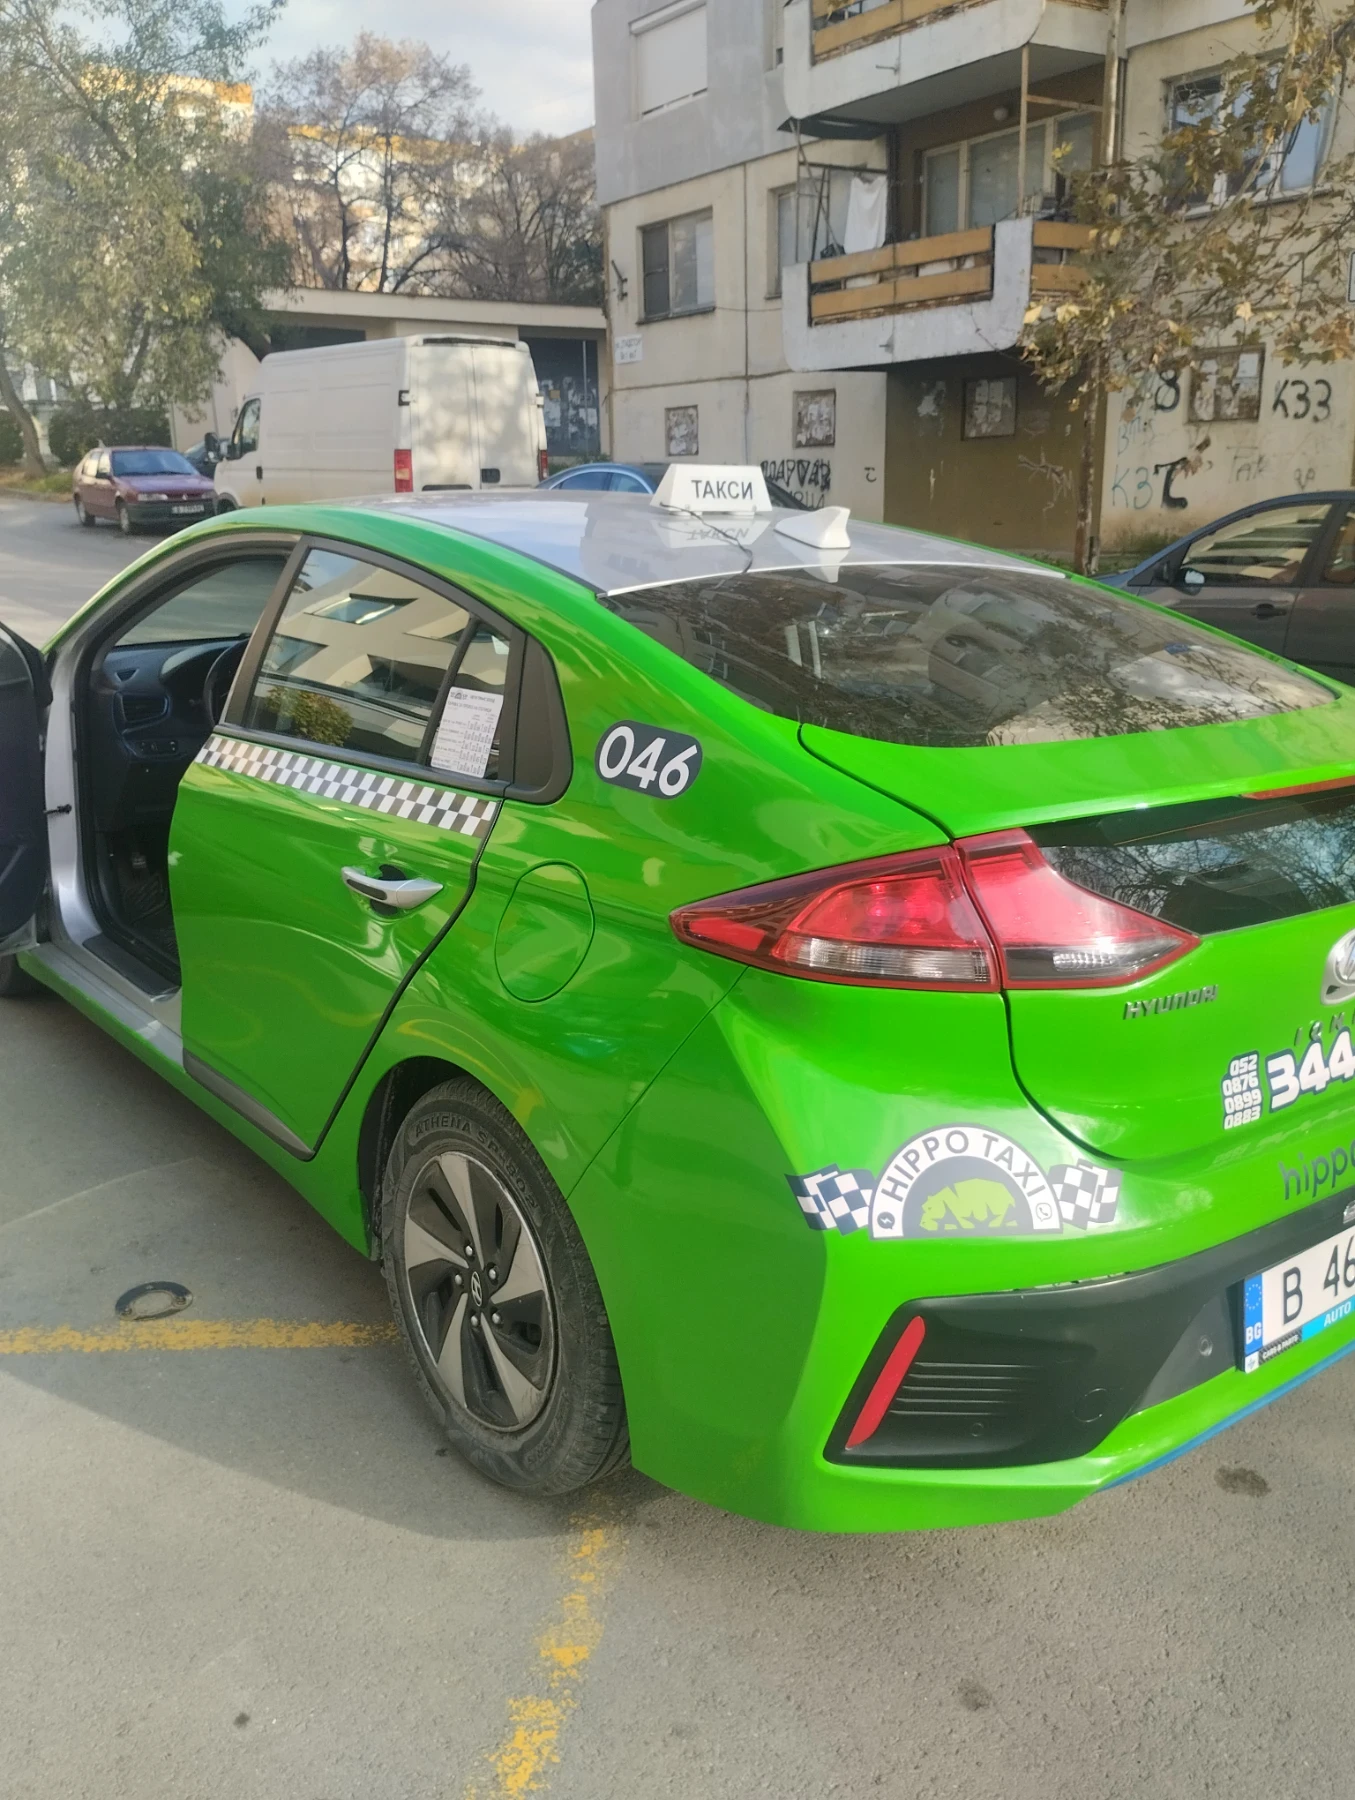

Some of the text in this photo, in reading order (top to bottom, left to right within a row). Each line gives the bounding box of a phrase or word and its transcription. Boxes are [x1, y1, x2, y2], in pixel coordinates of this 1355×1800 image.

[691, 479, 754, 501] ТАКСИ
[598, 725, 698, 796] 046
[1123, 984, 1219, 1020] HYUNDAI
[1230, 1054, 1258, 1077] 052
[1222, 1071, 1259, 1096] 0876
[1224, 1088, 1262, 1114] 0899
[1224, 1105, 1261, 1130] 0883
[881, 1130, 1046, 1202] HIPPO TAXI
[1283, 1235, 1355, 1325] B 46
[1323, 1301, 1352, 1328] AUTO
[1245, 1322, 1263, 1345] BG
